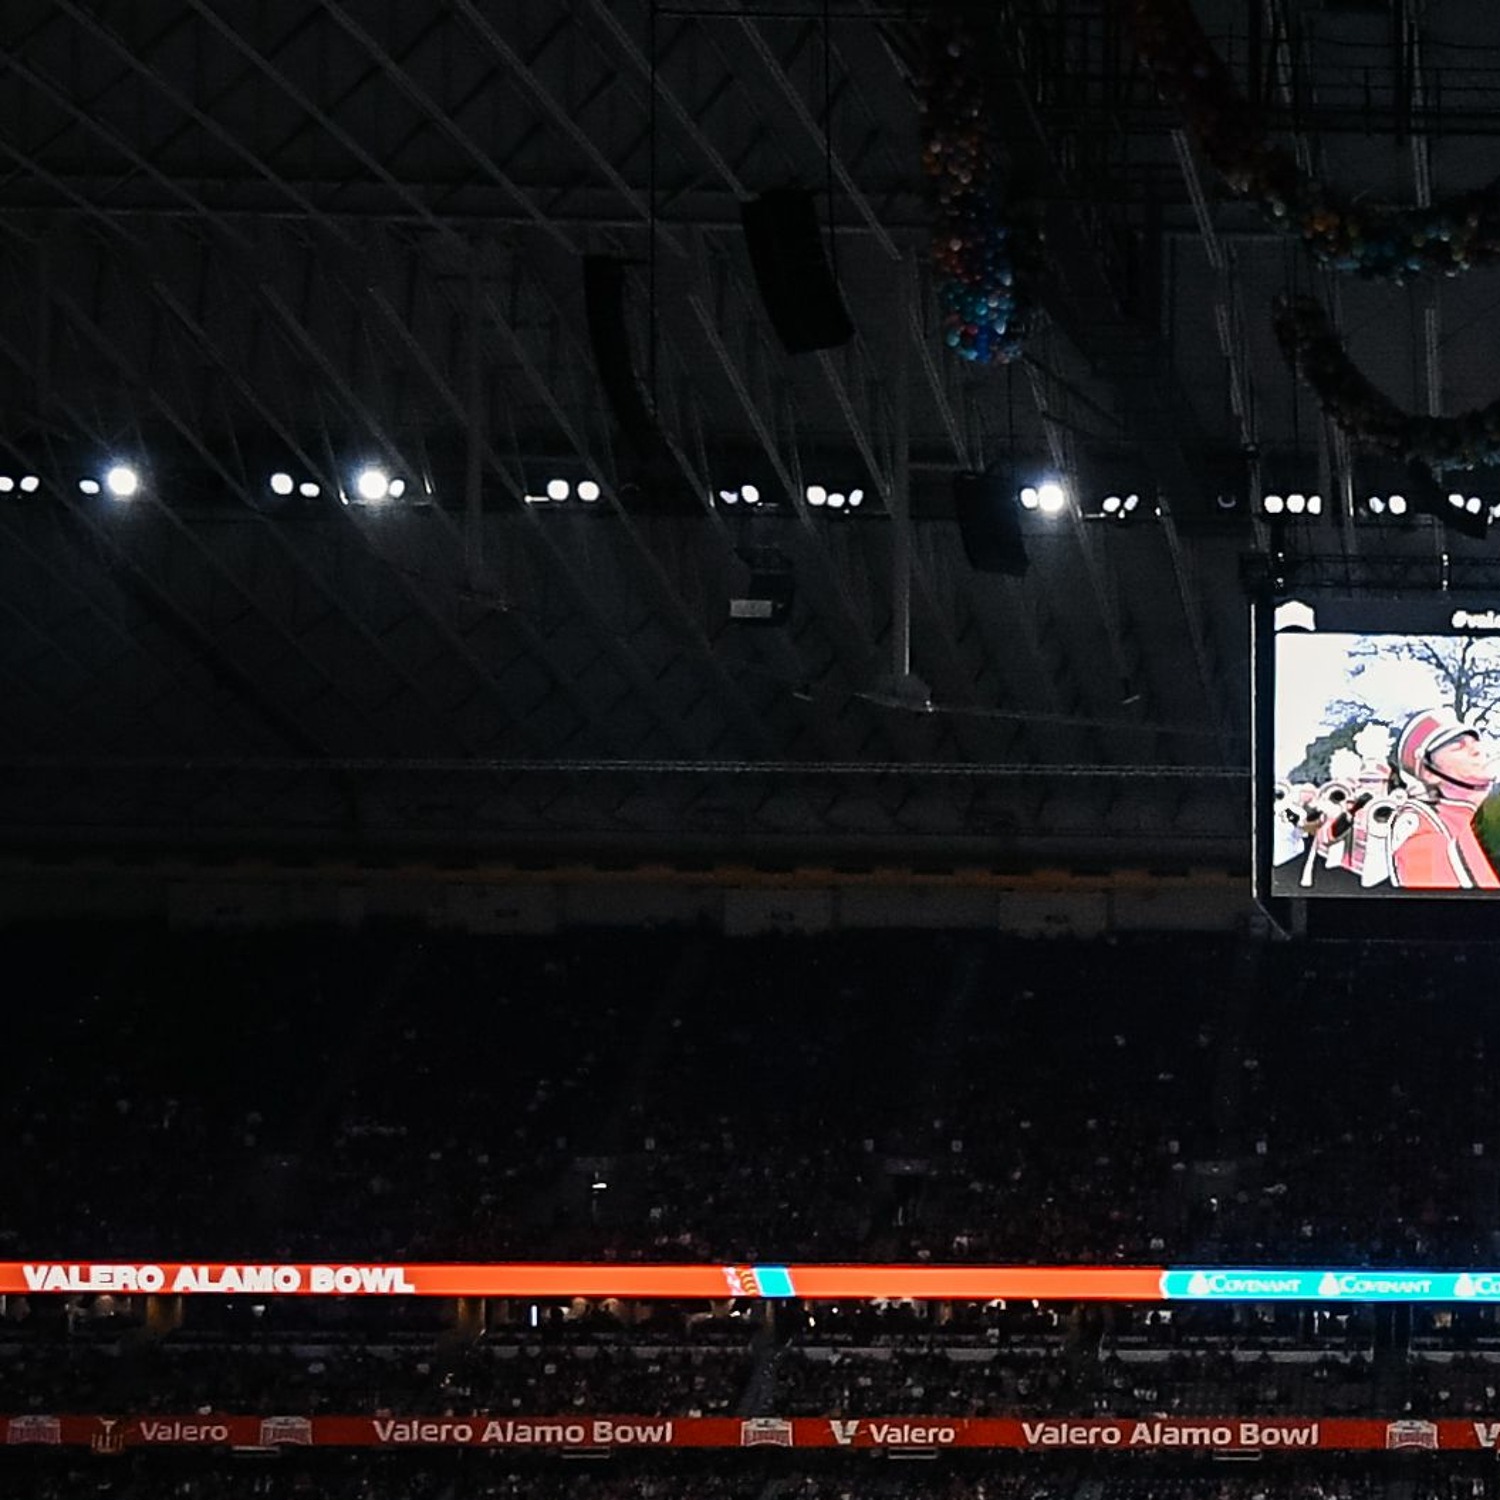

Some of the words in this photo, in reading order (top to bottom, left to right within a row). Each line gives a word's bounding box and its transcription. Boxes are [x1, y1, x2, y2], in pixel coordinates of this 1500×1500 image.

[22, 1265, 164, 1292] VALERO
[172, 1266, 300, 1293] ALAMO
[310, 1267, 415, 1294] BOWL
[139, 1421, 228, 1441] Valero
[373, 1420, 473, 1443] Valero
[481, 1420, 585, 1443] Alamo
[593, 1420, 672, 1443] Bowl
[869, 1424, 955, 1443] Valero
[1022, 1423, 1121, 1445] Valero
[1129, 1423, 1232, 1445] Alamo
[1239, 1423, 1319, 1445] Bowl
